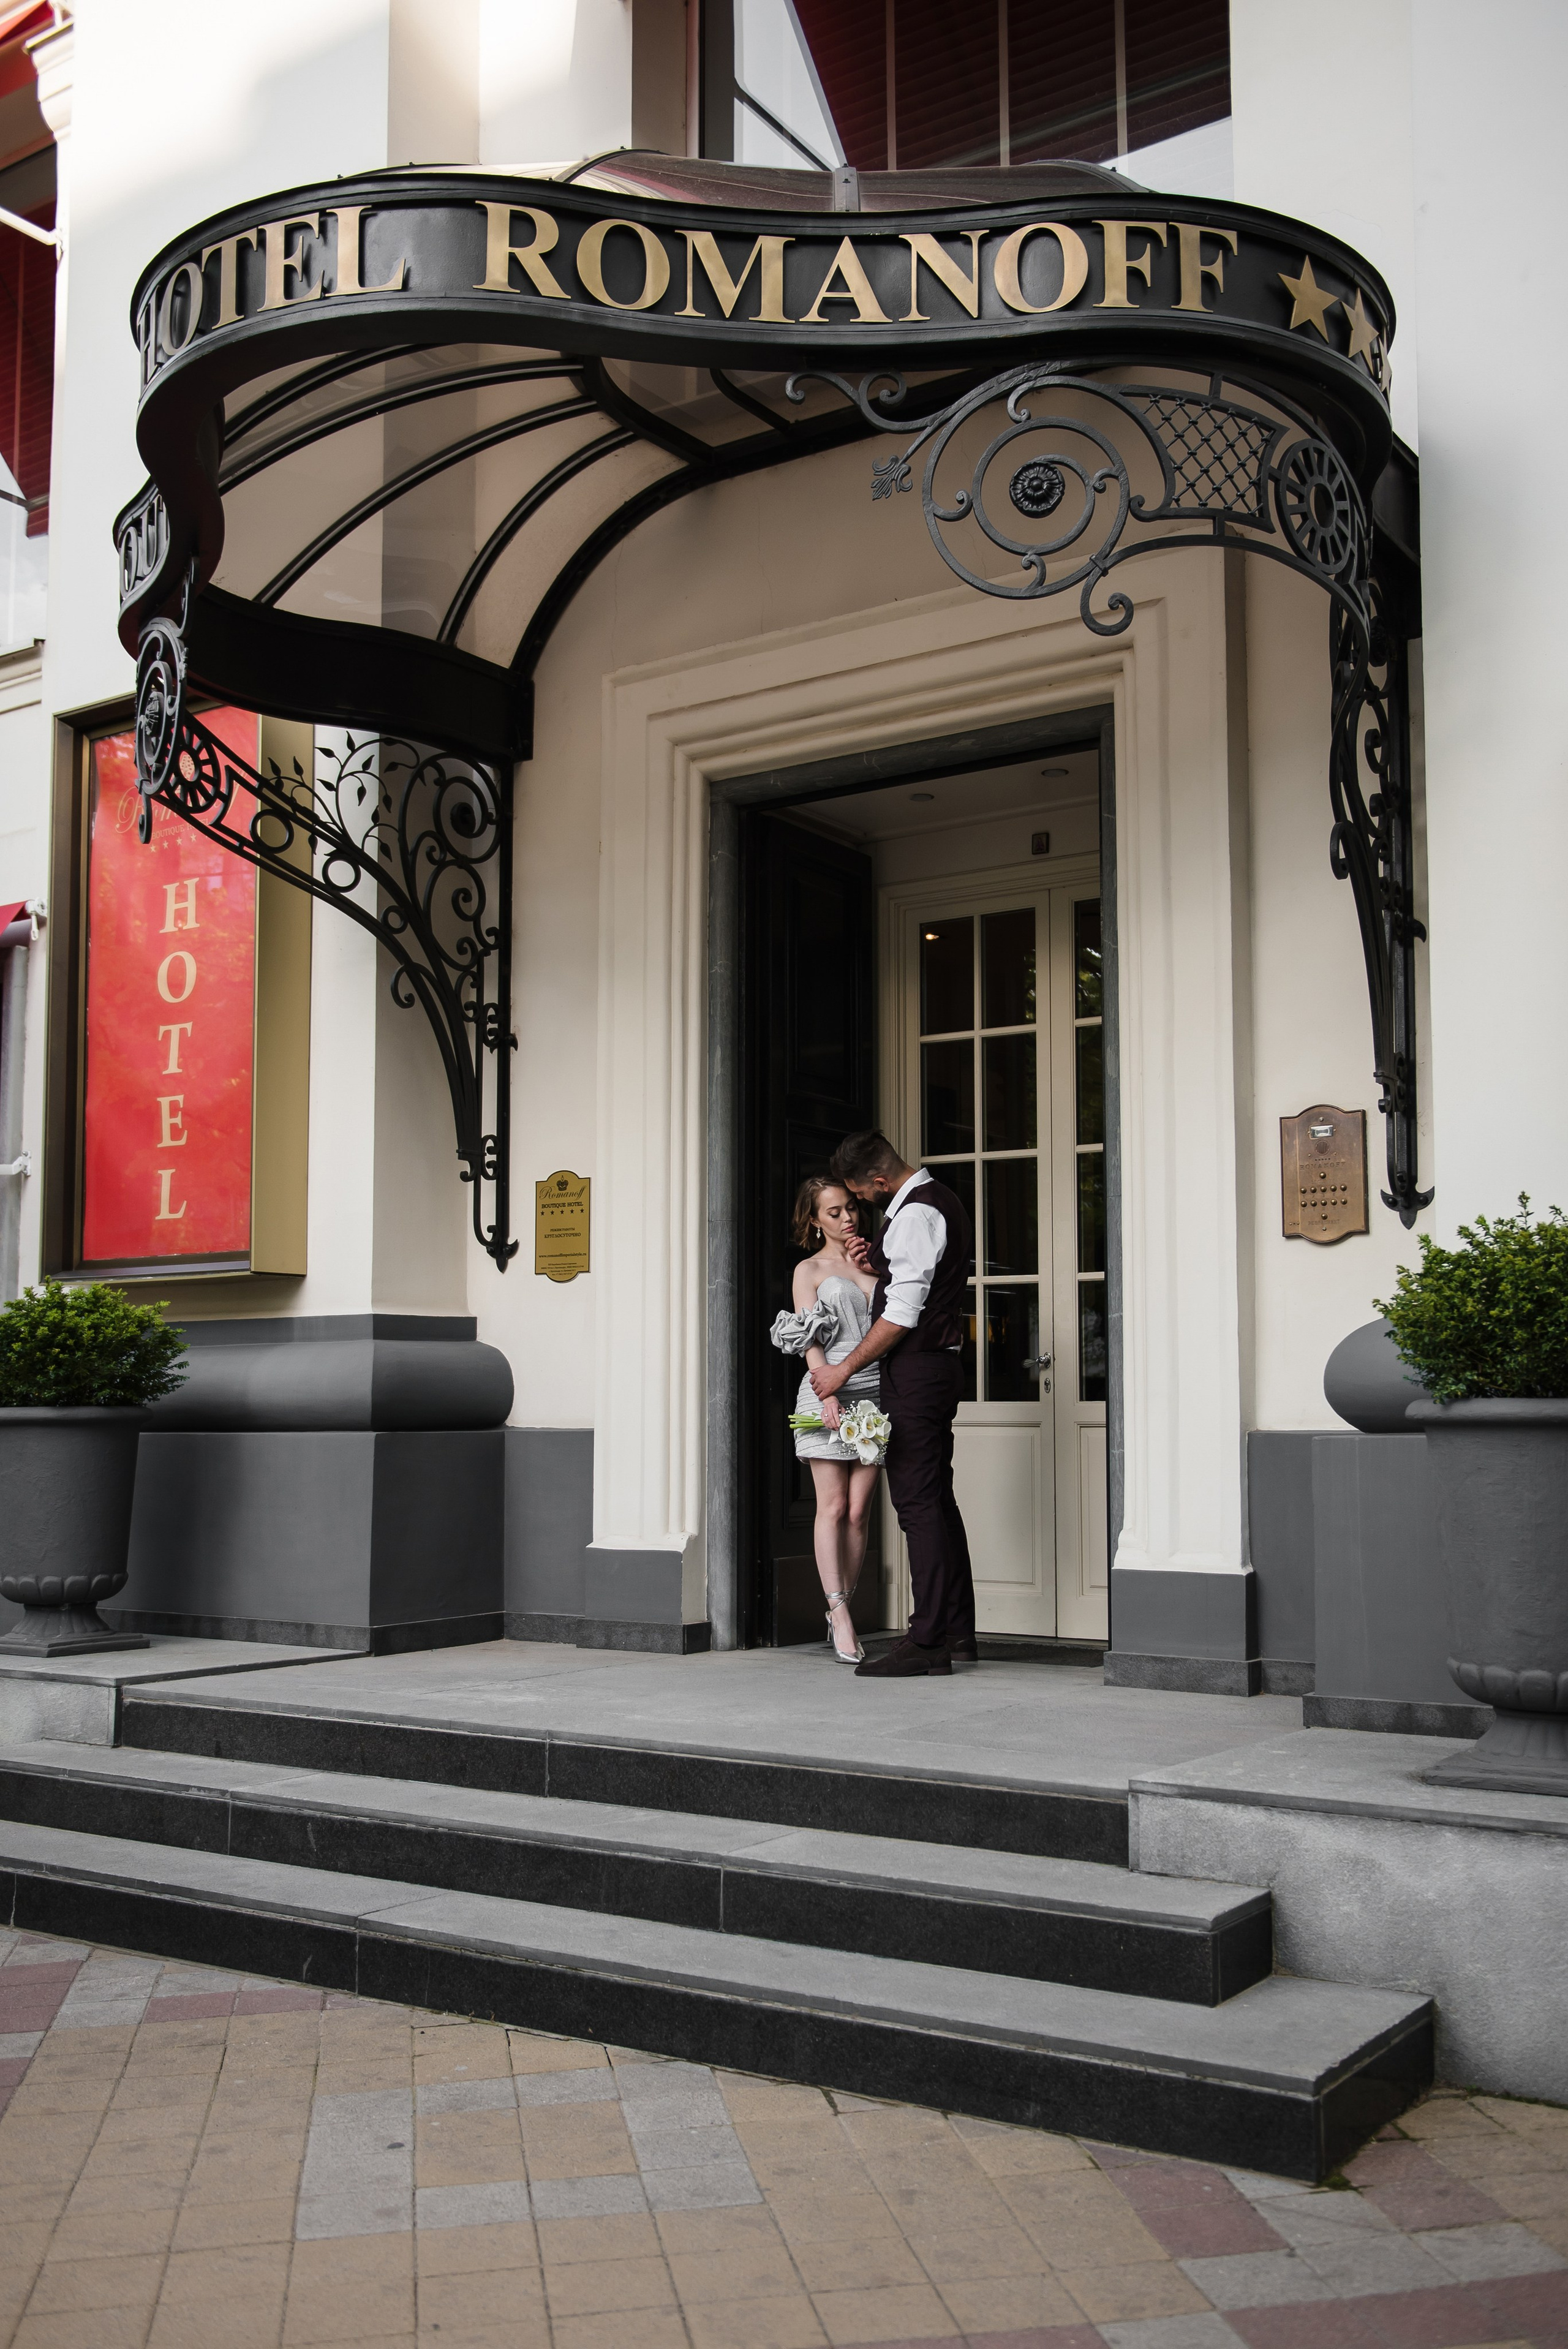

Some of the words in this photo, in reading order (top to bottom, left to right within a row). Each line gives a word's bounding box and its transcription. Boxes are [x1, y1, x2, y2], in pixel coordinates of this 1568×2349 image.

[137, 205, 406, 397] HOTEL
[473, 200, 1238, 323] ROMANOFF
[155, 877, 200, 1220] HOTEL
[539, 1185, 587, 1201] Romanoff
